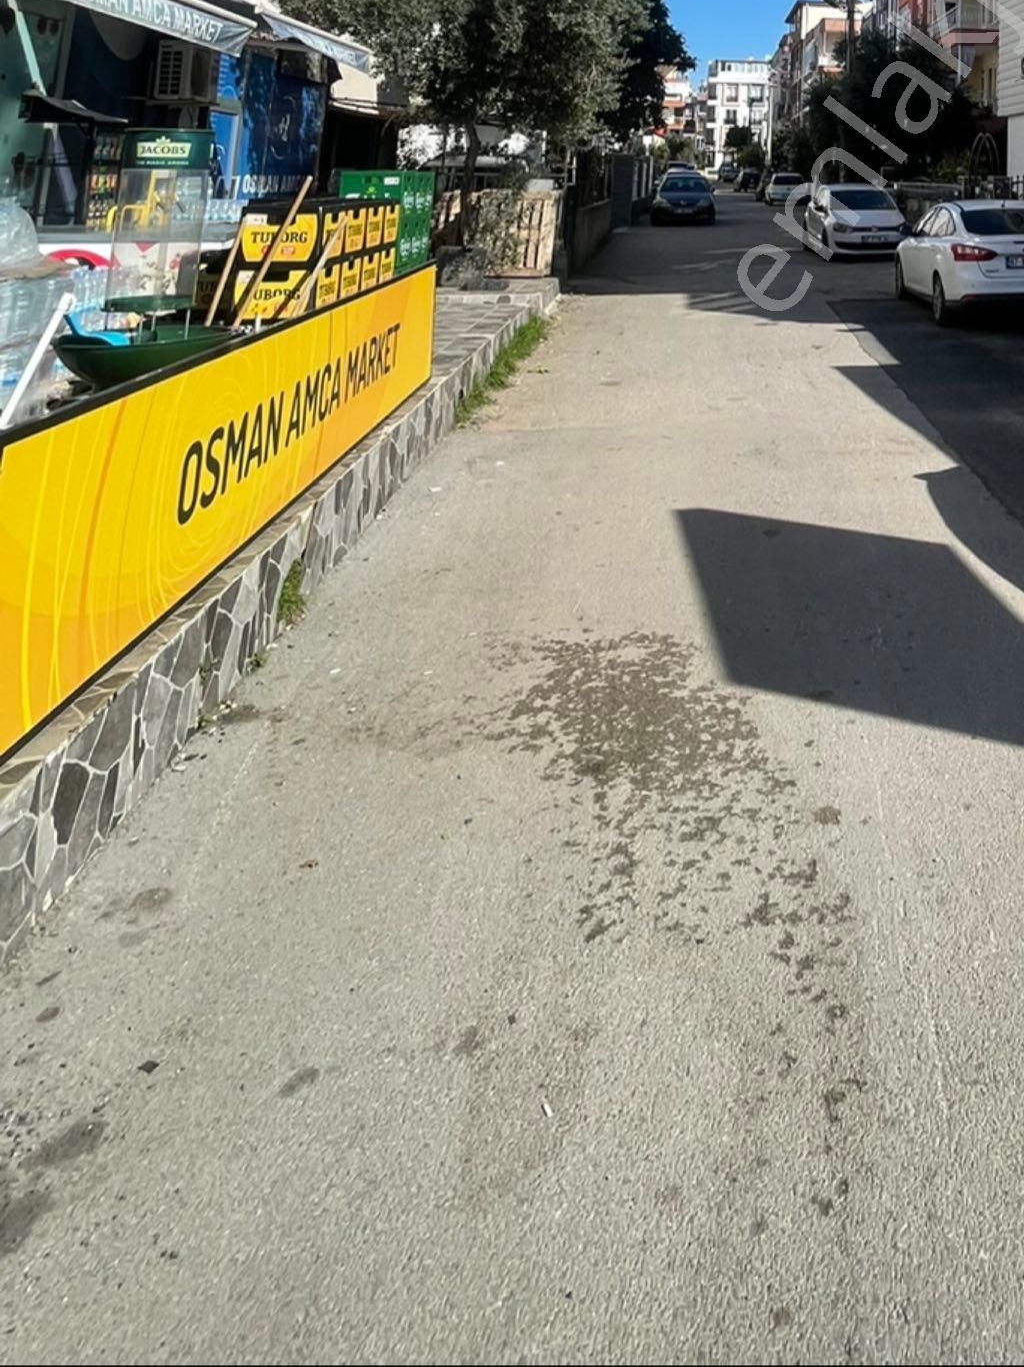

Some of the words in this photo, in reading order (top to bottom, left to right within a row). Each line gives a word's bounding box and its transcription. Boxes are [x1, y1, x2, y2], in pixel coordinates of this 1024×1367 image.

[173, 10, 223, 43] MARKET
[140, 144, 187, 155] JACOBS
[250, 231, 308, 243] TUORG
[177, 391, 284, 525] OSMAN
[285, 357, 341, 448] AMCA
[345, 322, 400, 403] MARKET
